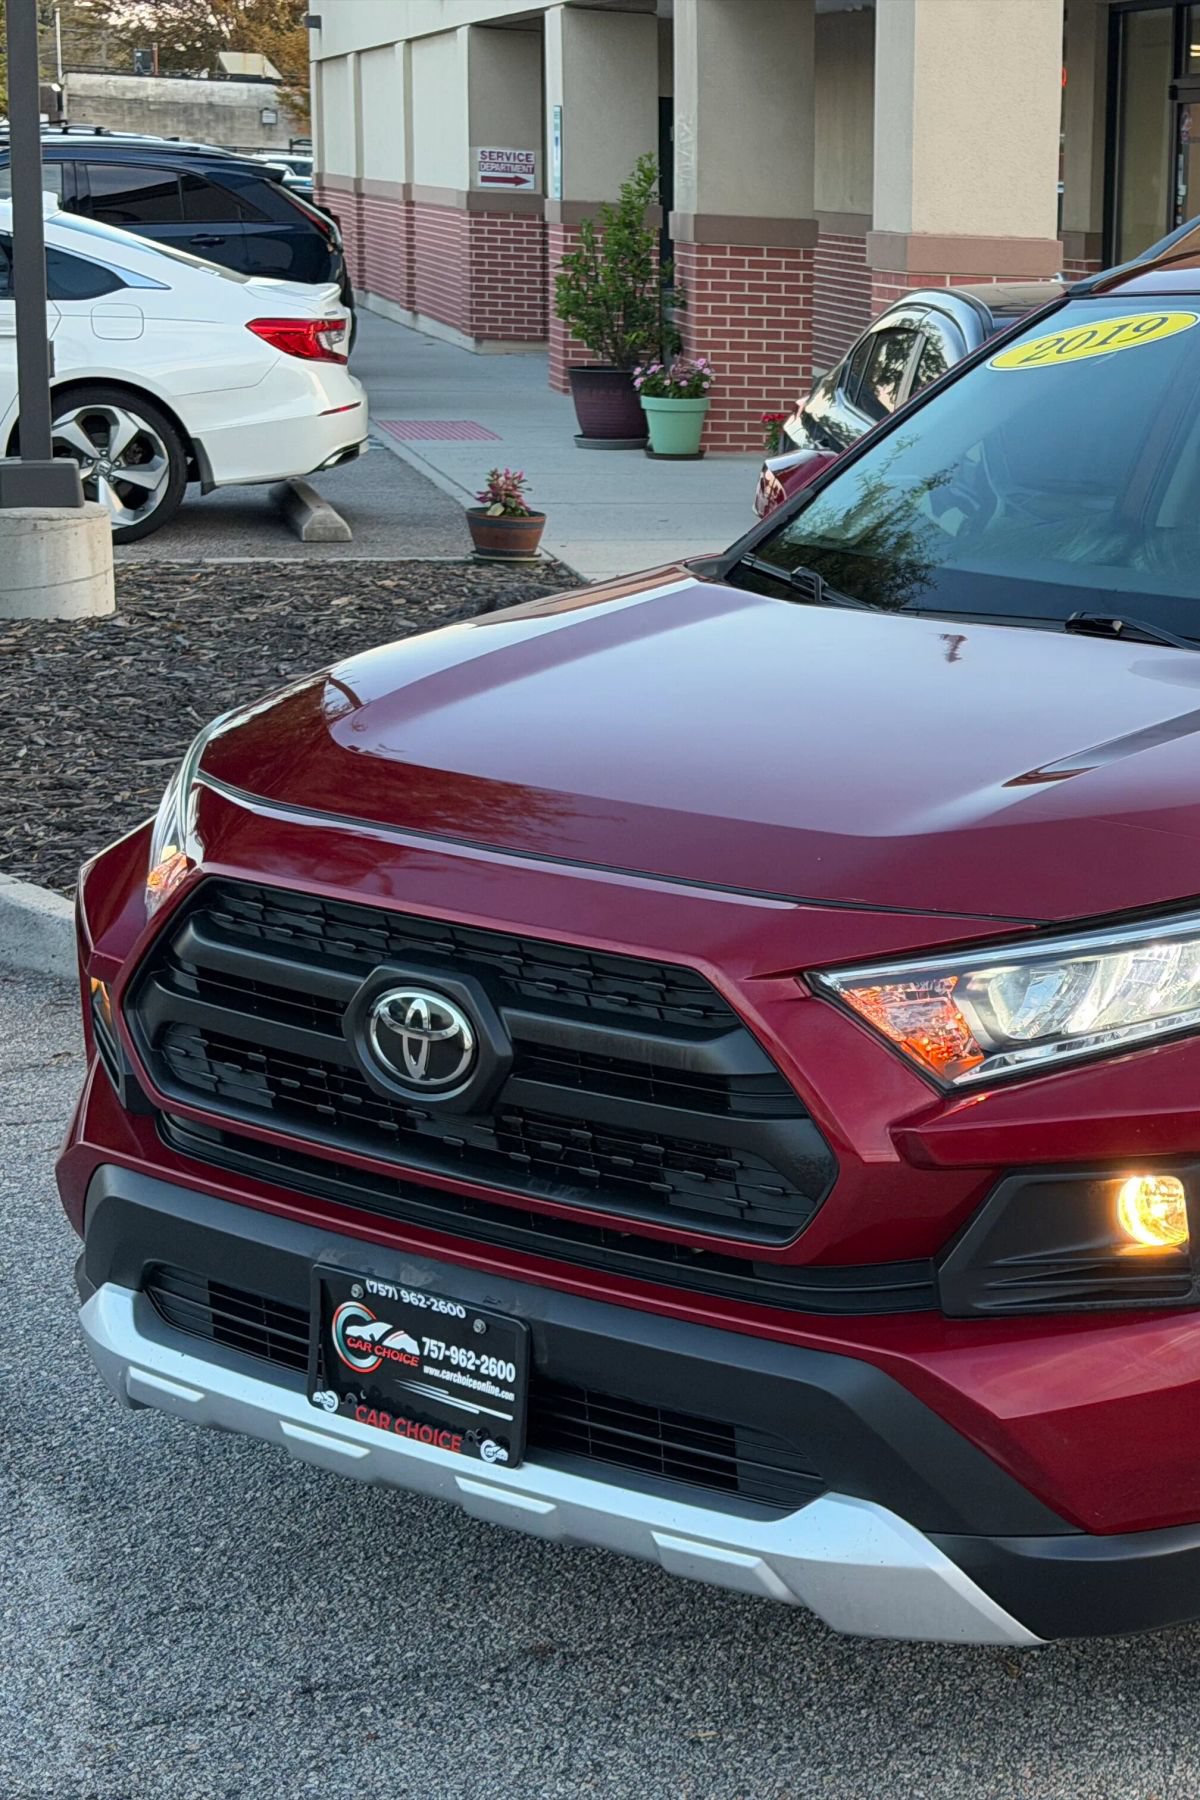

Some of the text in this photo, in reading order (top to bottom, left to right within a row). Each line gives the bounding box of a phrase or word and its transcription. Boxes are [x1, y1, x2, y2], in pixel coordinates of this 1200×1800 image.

[480, 150, 534, 163] SERVICE
[480, 162, 534, 174] DEPARTMENT
[1016, 316, 1169, 365] 2019
[366, 1279, 467, 1319] (757) 962-2600
[346, 1337, 421, 1367] CAR CHOICE
[422, 1336, 516, 1383] 757-962-2600
[423, 1365, 515, 1402] www.carchoiceonline.com
[355, 1403, 463, 1453] CAR CHOICE
